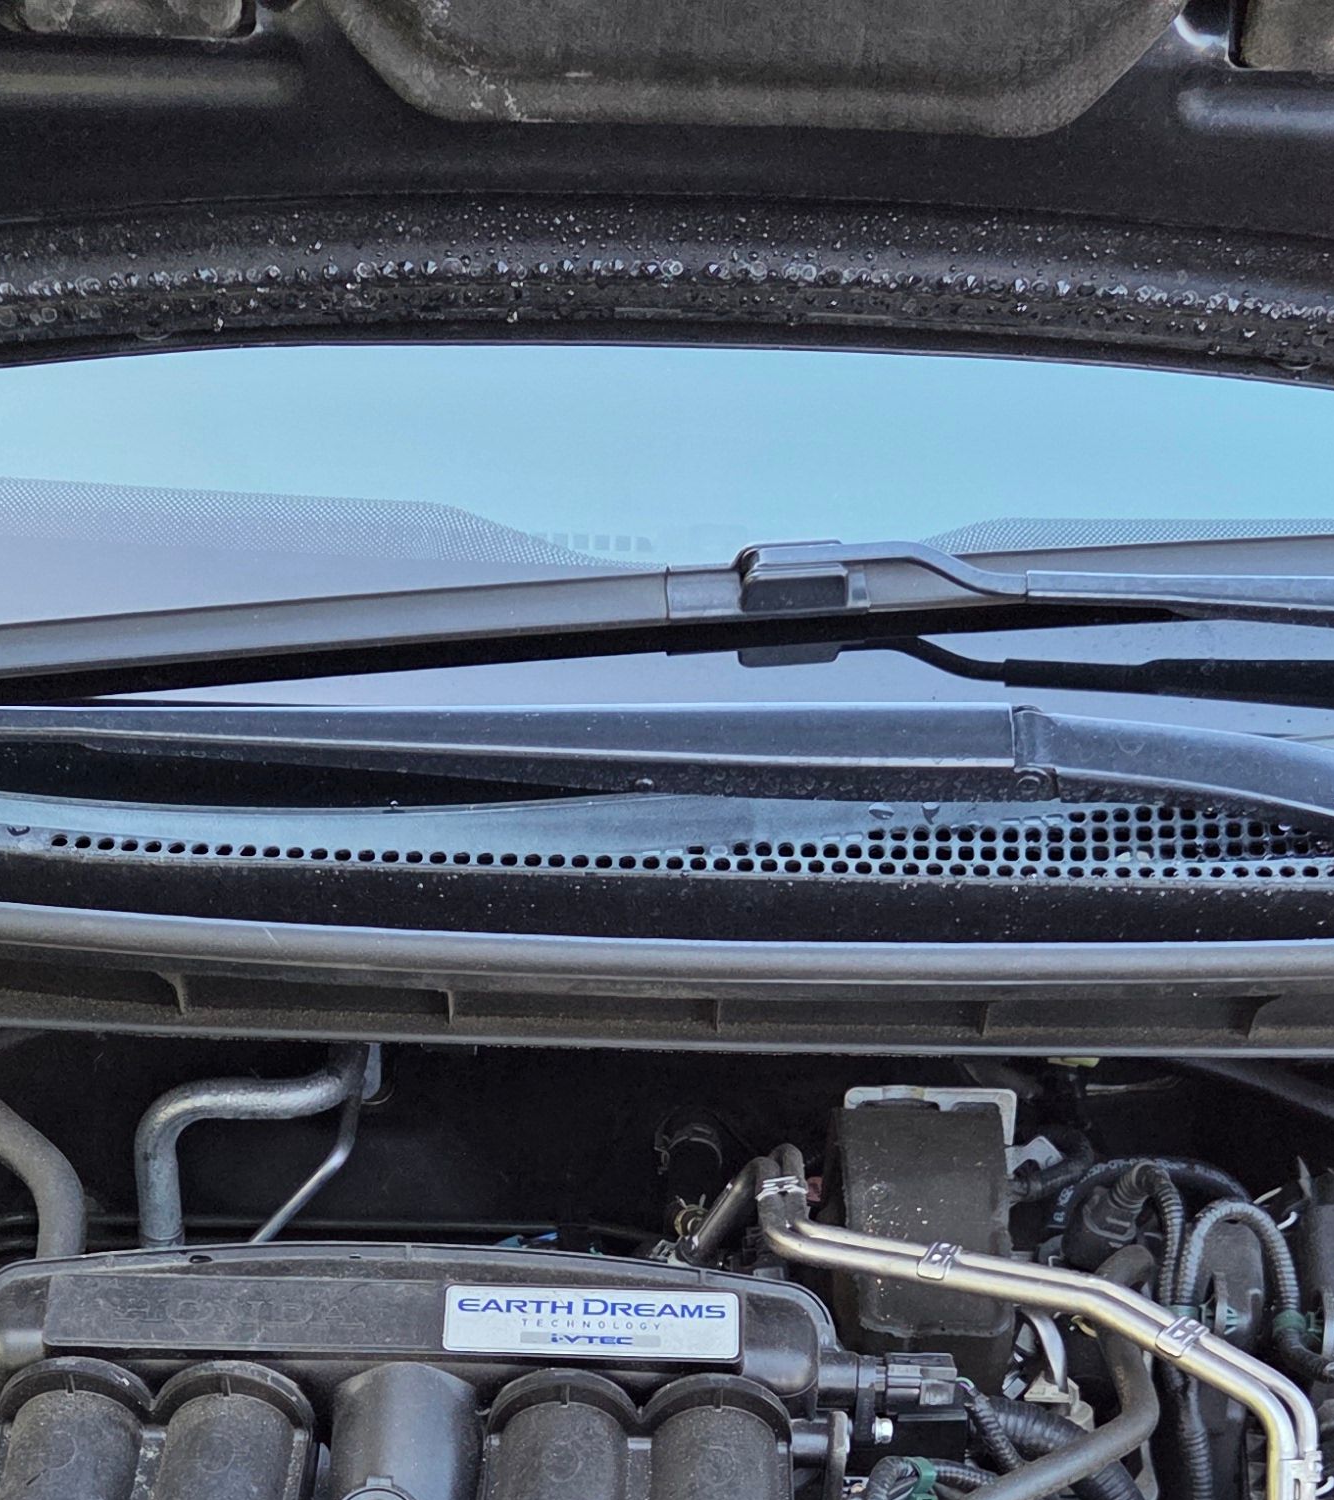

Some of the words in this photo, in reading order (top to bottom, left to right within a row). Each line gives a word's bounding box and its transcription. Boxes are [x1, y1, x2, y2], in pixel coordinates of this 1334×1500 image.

[457, 1298, 573, 1316] EARTH
[583, 1298, 726, 1319] DREAMS
[521, 1319, 662, 1331] TECHNOLOGY
